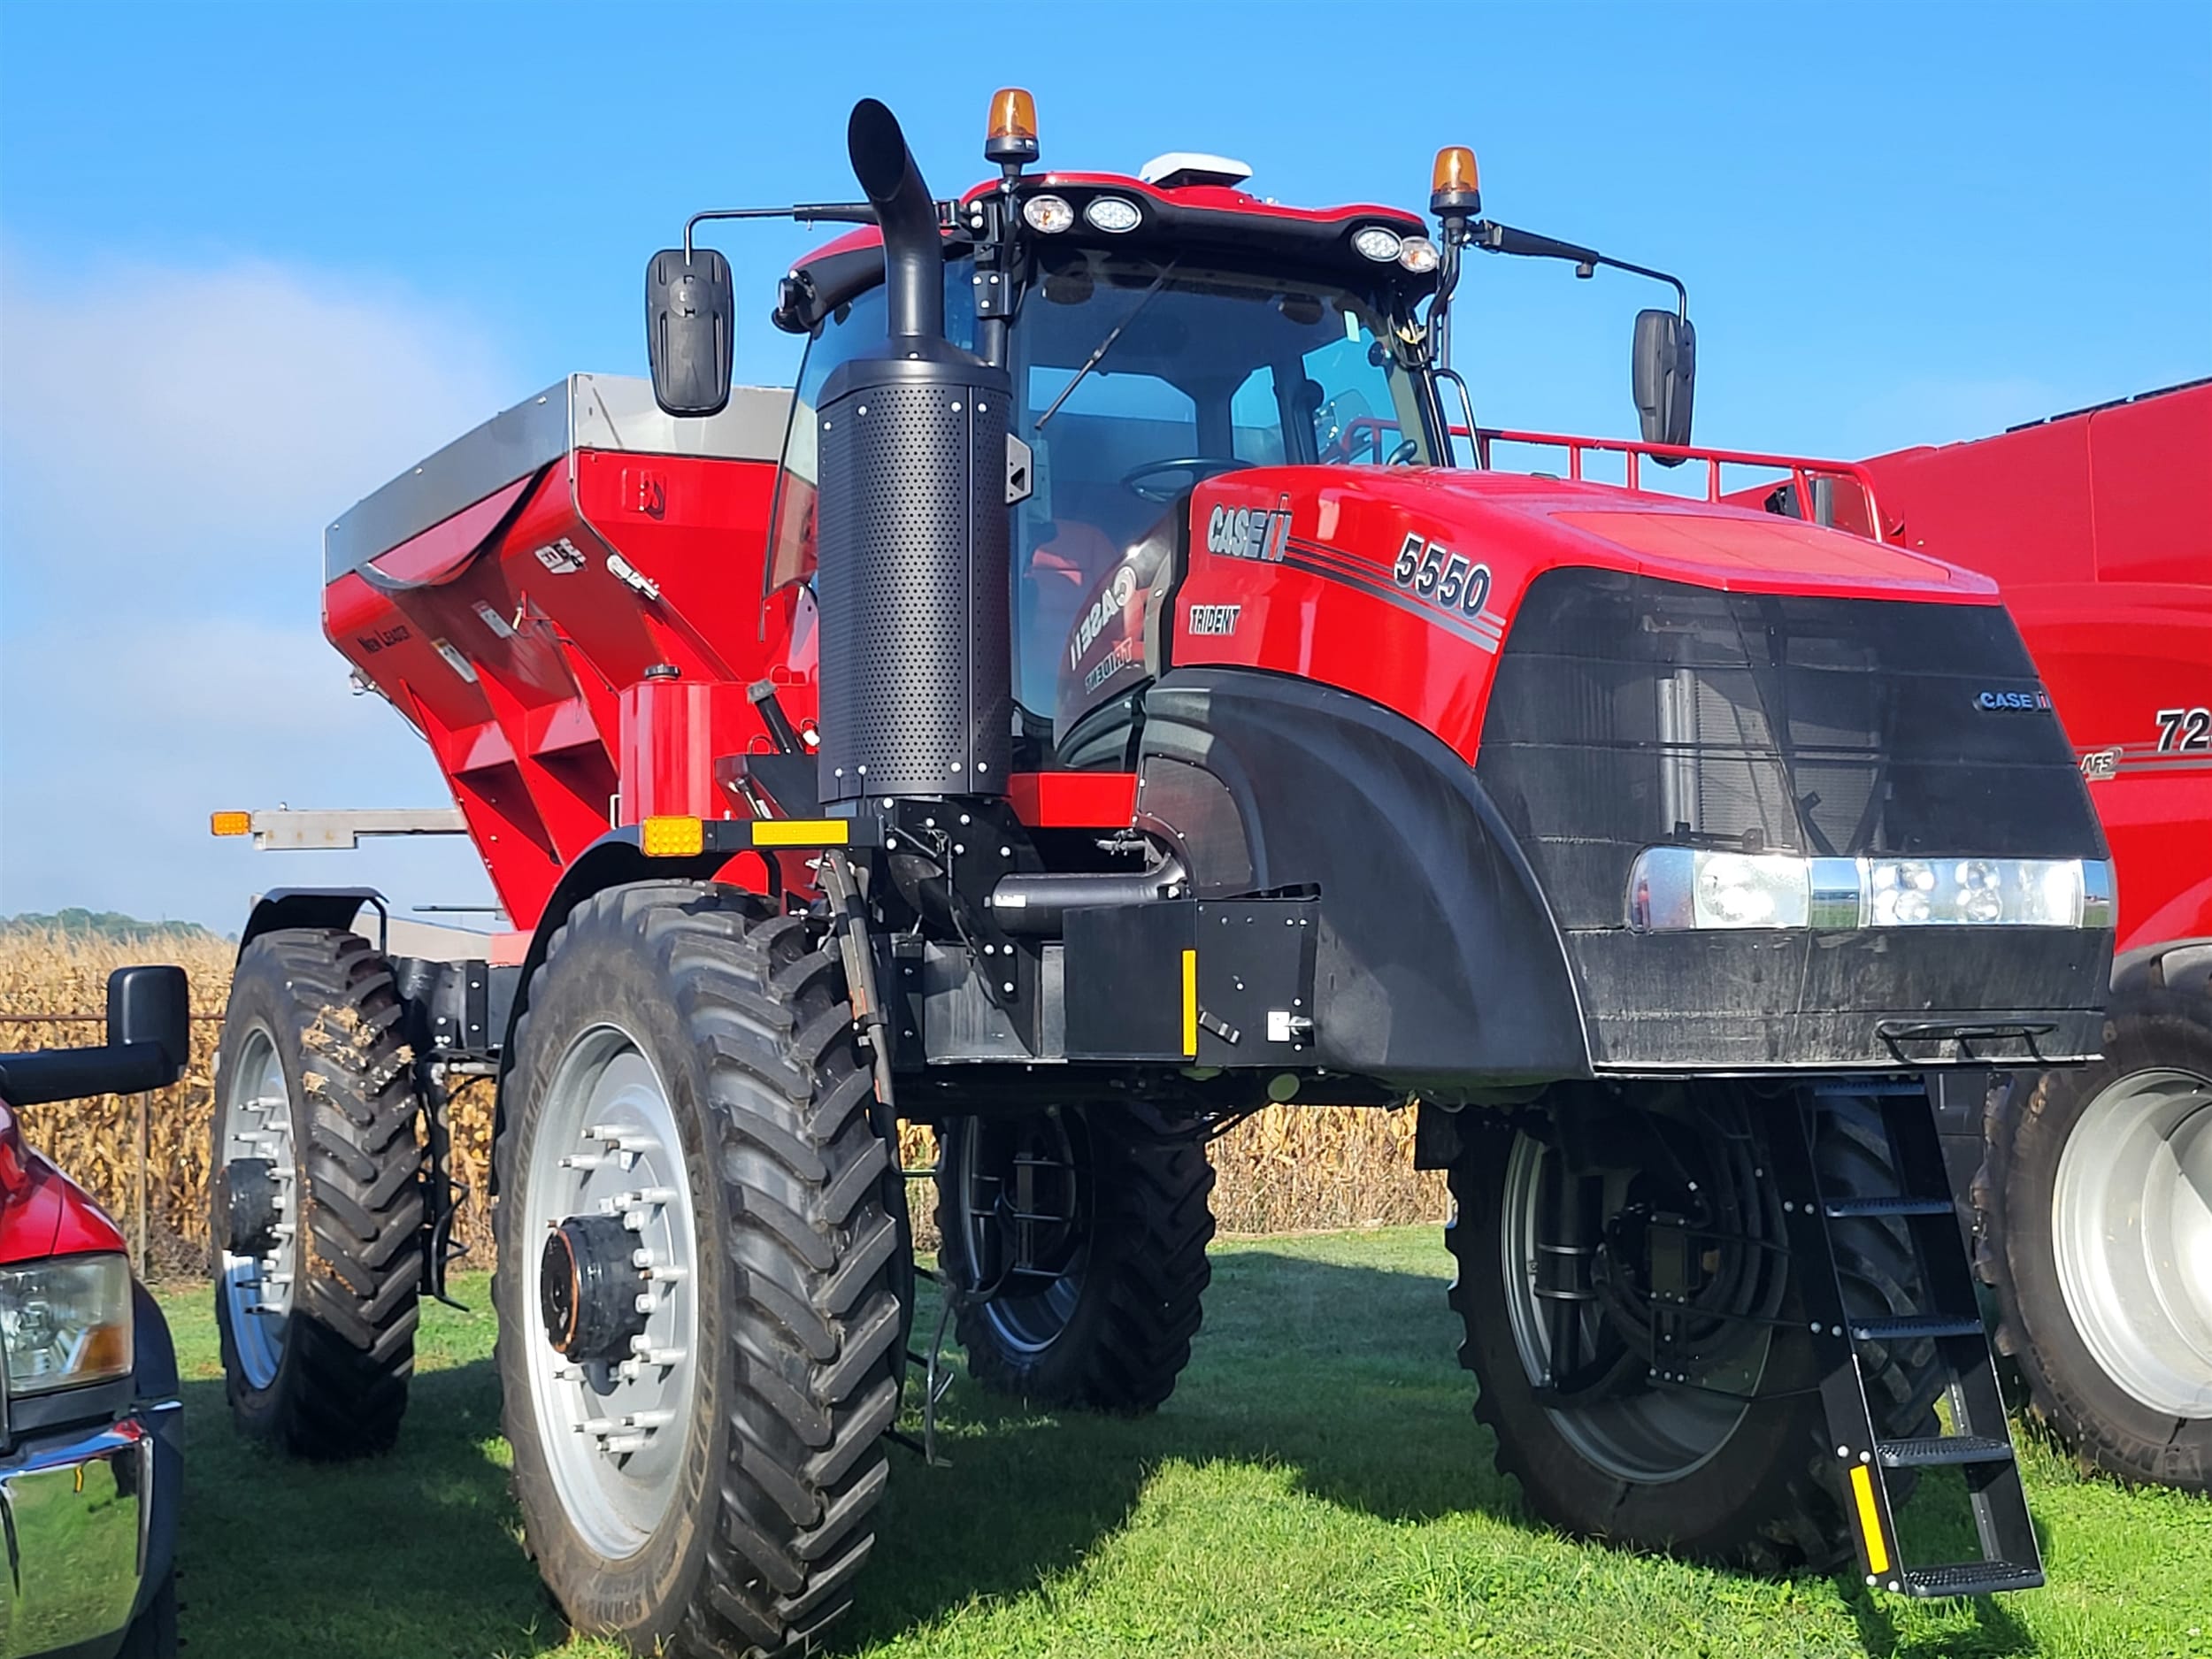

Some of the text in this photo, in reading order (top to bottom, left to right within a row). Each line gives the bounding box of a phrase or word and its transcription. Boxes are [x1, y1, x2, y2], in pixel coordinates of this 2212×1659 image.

[1207, 503, 1266, 560] CASE
[1394, 532, 1491, 619] 5550
[1188, 605, 1240, 635] TRIDENT
[1980, 692, 2033, 708] CASE
[2155, 708, 2212, 752] 72
[2079, 753, 2115, 773] AFS
